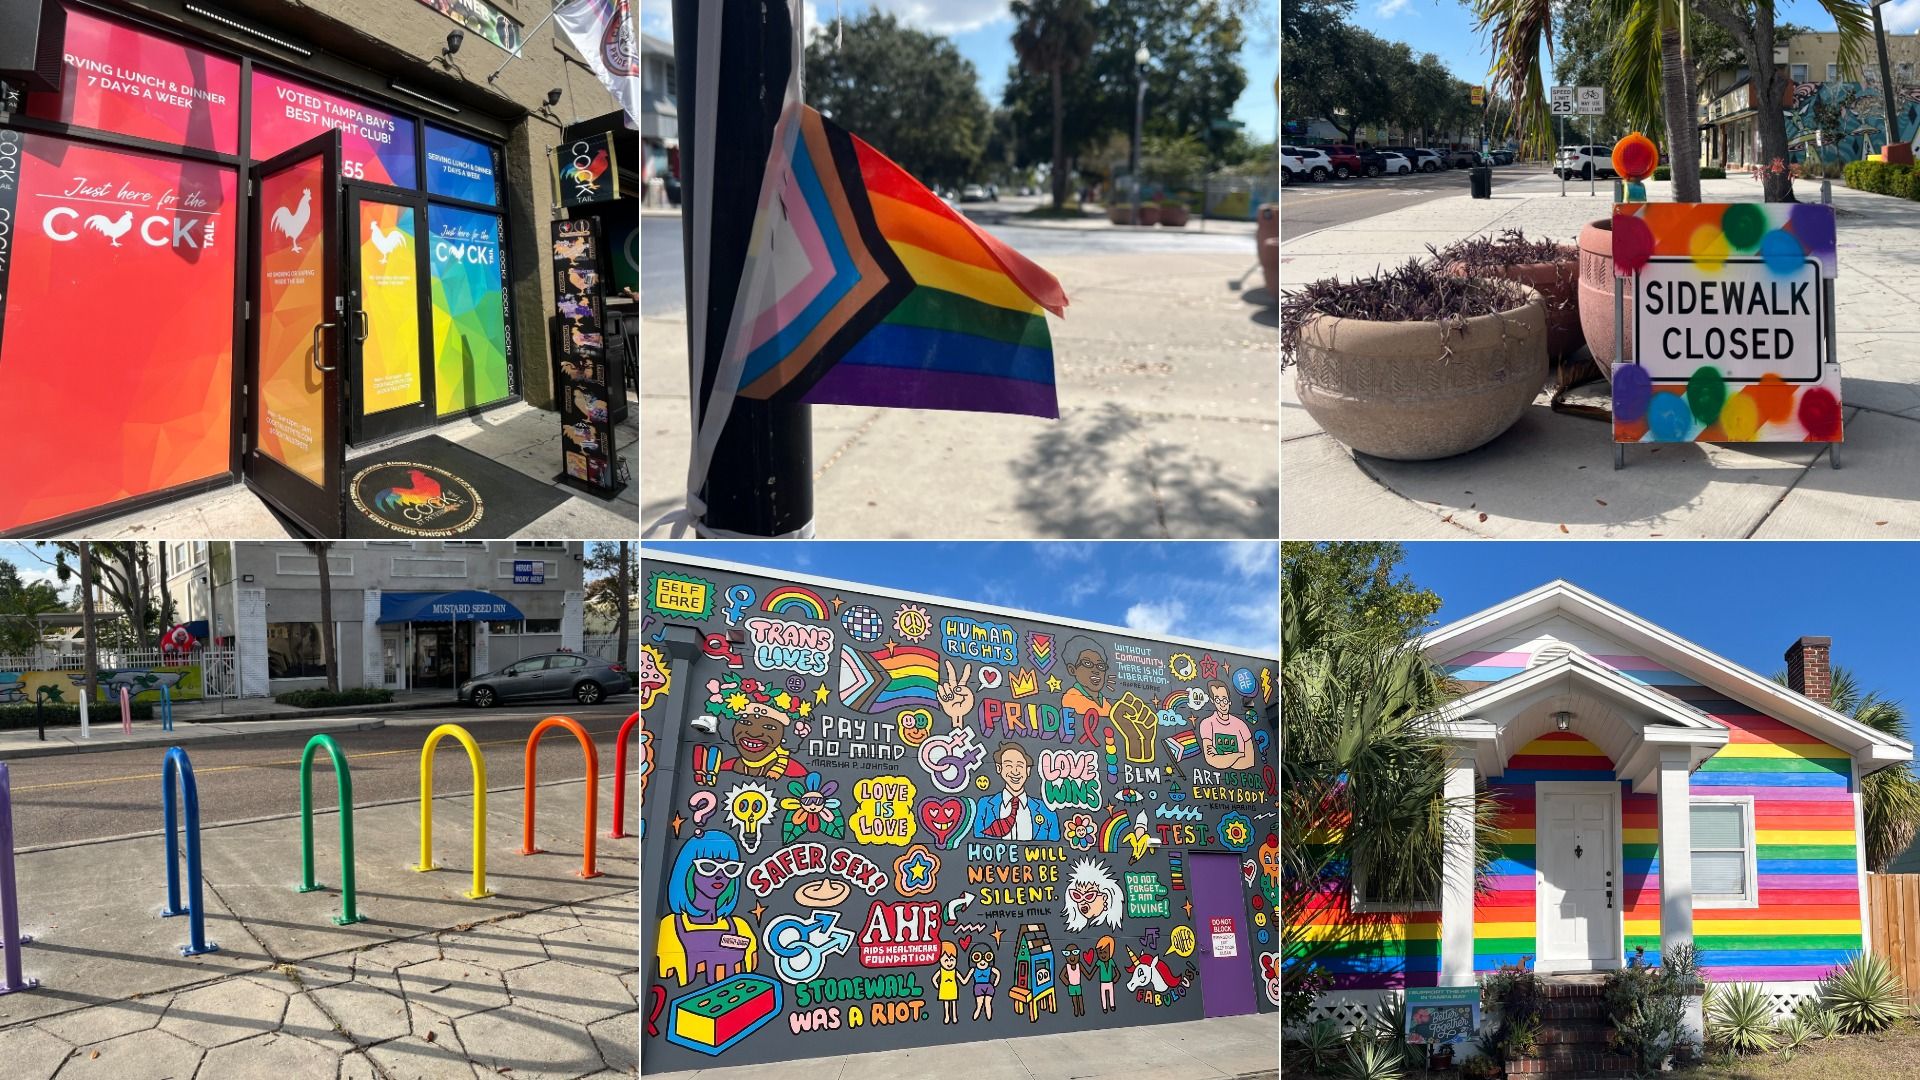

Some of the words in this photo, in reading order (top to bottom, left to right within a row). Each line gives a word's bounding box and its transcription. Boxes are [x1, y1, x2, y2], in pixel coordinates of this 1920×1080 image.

[87, 76, 97, 87] 7
[100, 78, 140, 97] DAYS
[142, 88, 153, 99] A
[155, 91, 194, 109] WEEK
[117, 68, 166, 90] LUNCH
[169, 81, 178, 92] &
[181, 84, 226, 105] DINNER
[276, 86, 322, 110] VOTED
[323, 101, 363, 122] TAMPA
[365, 112, 396, 132] BAY'S
[1553, 101, 1571, 112] 25
[285, 105, 319, 126] BEST
[321, 115, 358, 136] NIGHT
[360, 126, 392, 145] CLUB!
[427, 152, 452, 165] SERVING
[452, 159, 470, 169] LUNCH
[474, 165, 493, 176] DINNER
[447, 166, 461, 176] DAYS
[466, 171, 481, 180] WEEK
[571, 141, 594, 197] COCK
[64, 177, 112, 197] Just
[117, 181, 152, 201] here
[157, 188, 179, 210] for
[184, 190, 207, 208] the
[576, 195, 594, 203] TAIL
[203, 221, 215, 249] TAIL
[440, 224, 456, 237] Just
[457, 226, 470, 237] here
[481, 229, 489, 240] the
[1645, 280, 1811, 316] SIDEWALK
[1662, 327, 1795, 360] CLOSED
[403, 491, 457, 521] COCK
[661, 581, 700, 595] SELF
[432, 604, 470, 614] MUSTARD
[472, 603, 491, 613] SEED
[493, 604, 506, 613] INN
[660, 593, 700, 608] CARE
[749, 619, 831, 650] TRANS
[946, 619, 1014, 645] HUMAN
[757, 645, 826, 672] LIVES
[947, 638, 1013, 662] RIGHTS
[1114, 642, 1151, 656] WITHOUT
[1116, 661, 1142, 674] THERE
[1143, 666, 1151, 675] IS
[1152, 668, 1164, 676] NO
[1238, 670, 1249, 681] BI
[1240, 679, 1252, 690] AF
[821, 714, 867, 740] PAY
[872, 722, 896, 743] IT
[978, 698, 1076, 743] PRIDE
[807, 739, 840, 758] NO
[849, 742, 906, 762] MIND
[1041, 752, 1097, 781] LOVE
[1124, 763, 1161, 784] BLM
[1193, 768, 1221, 786] ART
[1225, 771, 1238, 786] IS
[1240, 771, 1263, 789] FOR
[861, 782, 909, 802] LOVE
[1045, 778, 1100, 809] WINS
[1192, 786, 1268, 804] EVERYBODY.
[874, 800, 894, 819] IS
[859, 815, 909, 837] LOVE
[1156, 823, 1209, 846] TEST
[967, 843, 1020, 864] HOPE
[1024, 846, 1068, 862] WILL
[750, 846, 826, 895] SAFER
[832, 850, 887, 894] SEX!
[967, 864, 1035, 885] NEVER
[1038, 864, 1059, 883] BE
[1126, 875, 1139, 884] DO
[1140, 875, 1157, 885] NOT
[979, 886, 1059, 905] SILENT.
[1137, 893, 1153, 901] AM
[1027, 908, 1051, 917] MILK
[1130, 900, 1169, 915] DIVINE!
[863, 904, 938, 943] AHF
[863, 945, 885, 954] AIDS
[886, 943, 938, 954] HEALTHCARE
[865, 952, 936, 964] FOUNDATION
[795, 971, 923, 1007] STONEWALL
[1136, 961, 1200, 1007] FABULOUS!
[789, 1005, 841, 1035] WAS
[847, 1005, 864, 1028] A
[870, 1000, 930, 1026] RIOT.
[1431, 1008, 1459, 1023] Better
